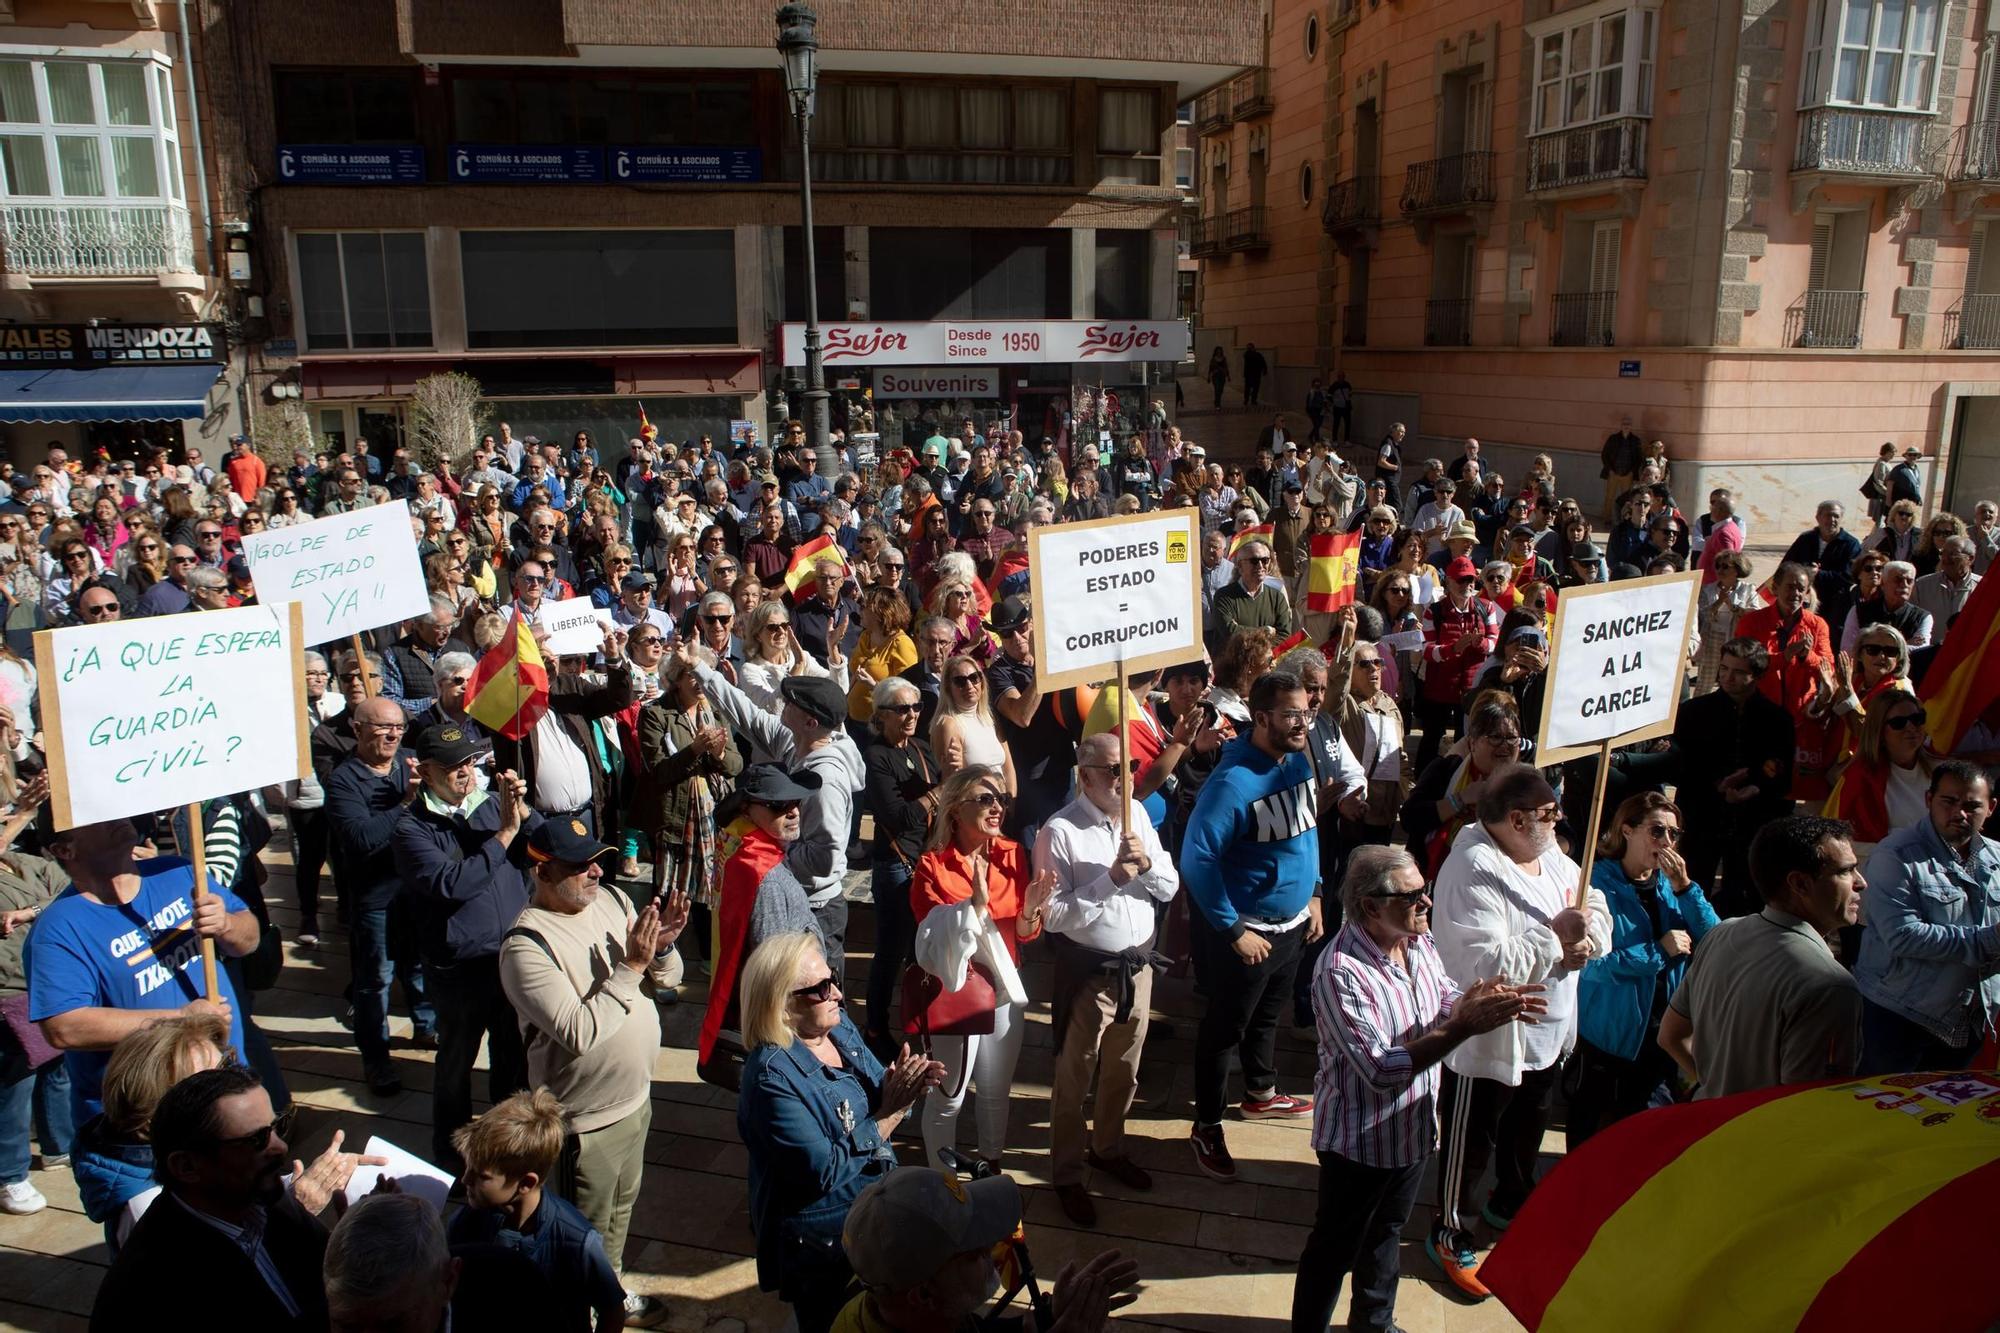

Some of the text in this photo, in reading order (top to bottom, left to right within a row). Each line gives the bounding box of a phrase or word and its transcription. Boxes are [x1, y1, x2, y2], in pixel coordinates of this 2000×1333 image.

[301, 154, 391, 164] COMUÑAS & ASOCIADOS
[476, 154, 562, 164] COMUÑAS & ASOCIADOS
[636, 154, 720, 165] COMUÑAS & ASOCIADOS
[86, 328, 213, 348] MENDOZA
[822, 326, 908, 361] Sajor
[948, 328, 992, 342] Desde
[1001, 332, 1040, 352] 1950
[1078, 324, 1160, 358] Sajor
[948, 344, 988, 357] Since
[882, 374, 989, 394] Souvenirs
[346, 523, 373, 541] DE
[1079, 541, 1159, 566] PODERES
[290, 555, 375, 589] ESTADO
[1086, 568, 1155, 593] ESTADO
[322, 588, 359, 625] YA
[1120, 602, 1128, 612] =
[552, 614, 596, 632] LIBERTAD
[1066, 616, 1179, 651] CORRUPCION
[1582, 610, 1672, 644] SANCHEZ
[64, 630, 282, 682] ¿A QUE ESPERA
[1602, 650, 1642, 678] A LA
[160, 674, 193, 697] LA
[1581, 684, 1652, 718] CARCEL
[110, 929, 145, 958] QUE
